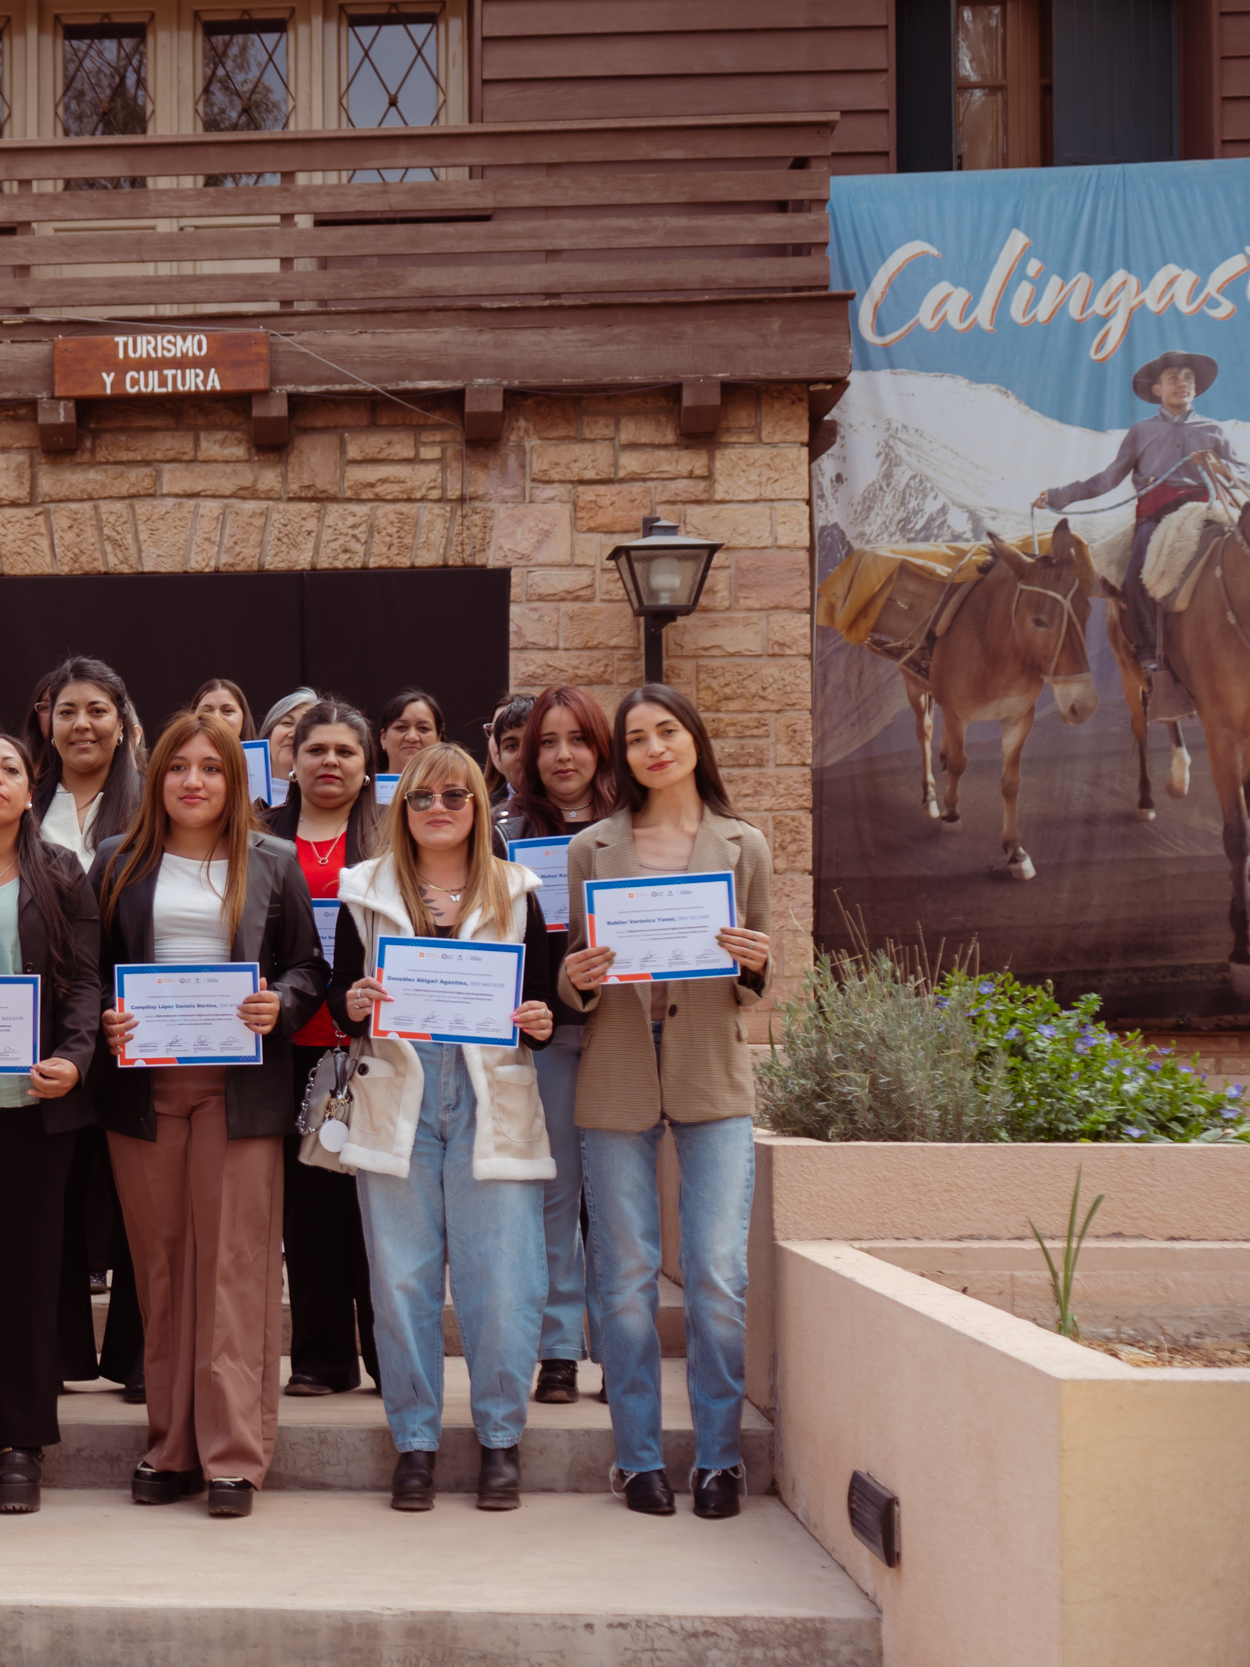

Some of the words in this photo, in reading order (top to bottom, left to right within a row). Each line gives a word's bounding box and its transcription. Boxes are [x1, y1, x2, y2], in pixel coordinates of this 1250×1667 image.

[858, 227, 1250, 362] Calingas
[114, 334, 207, 359] TURISMO
[102, 372, 115, 394] Y
[125, 367, 221, 393] CULTURA
[387, 975, 415, 983] González
[439, 979, 469, 987] Agostina,
